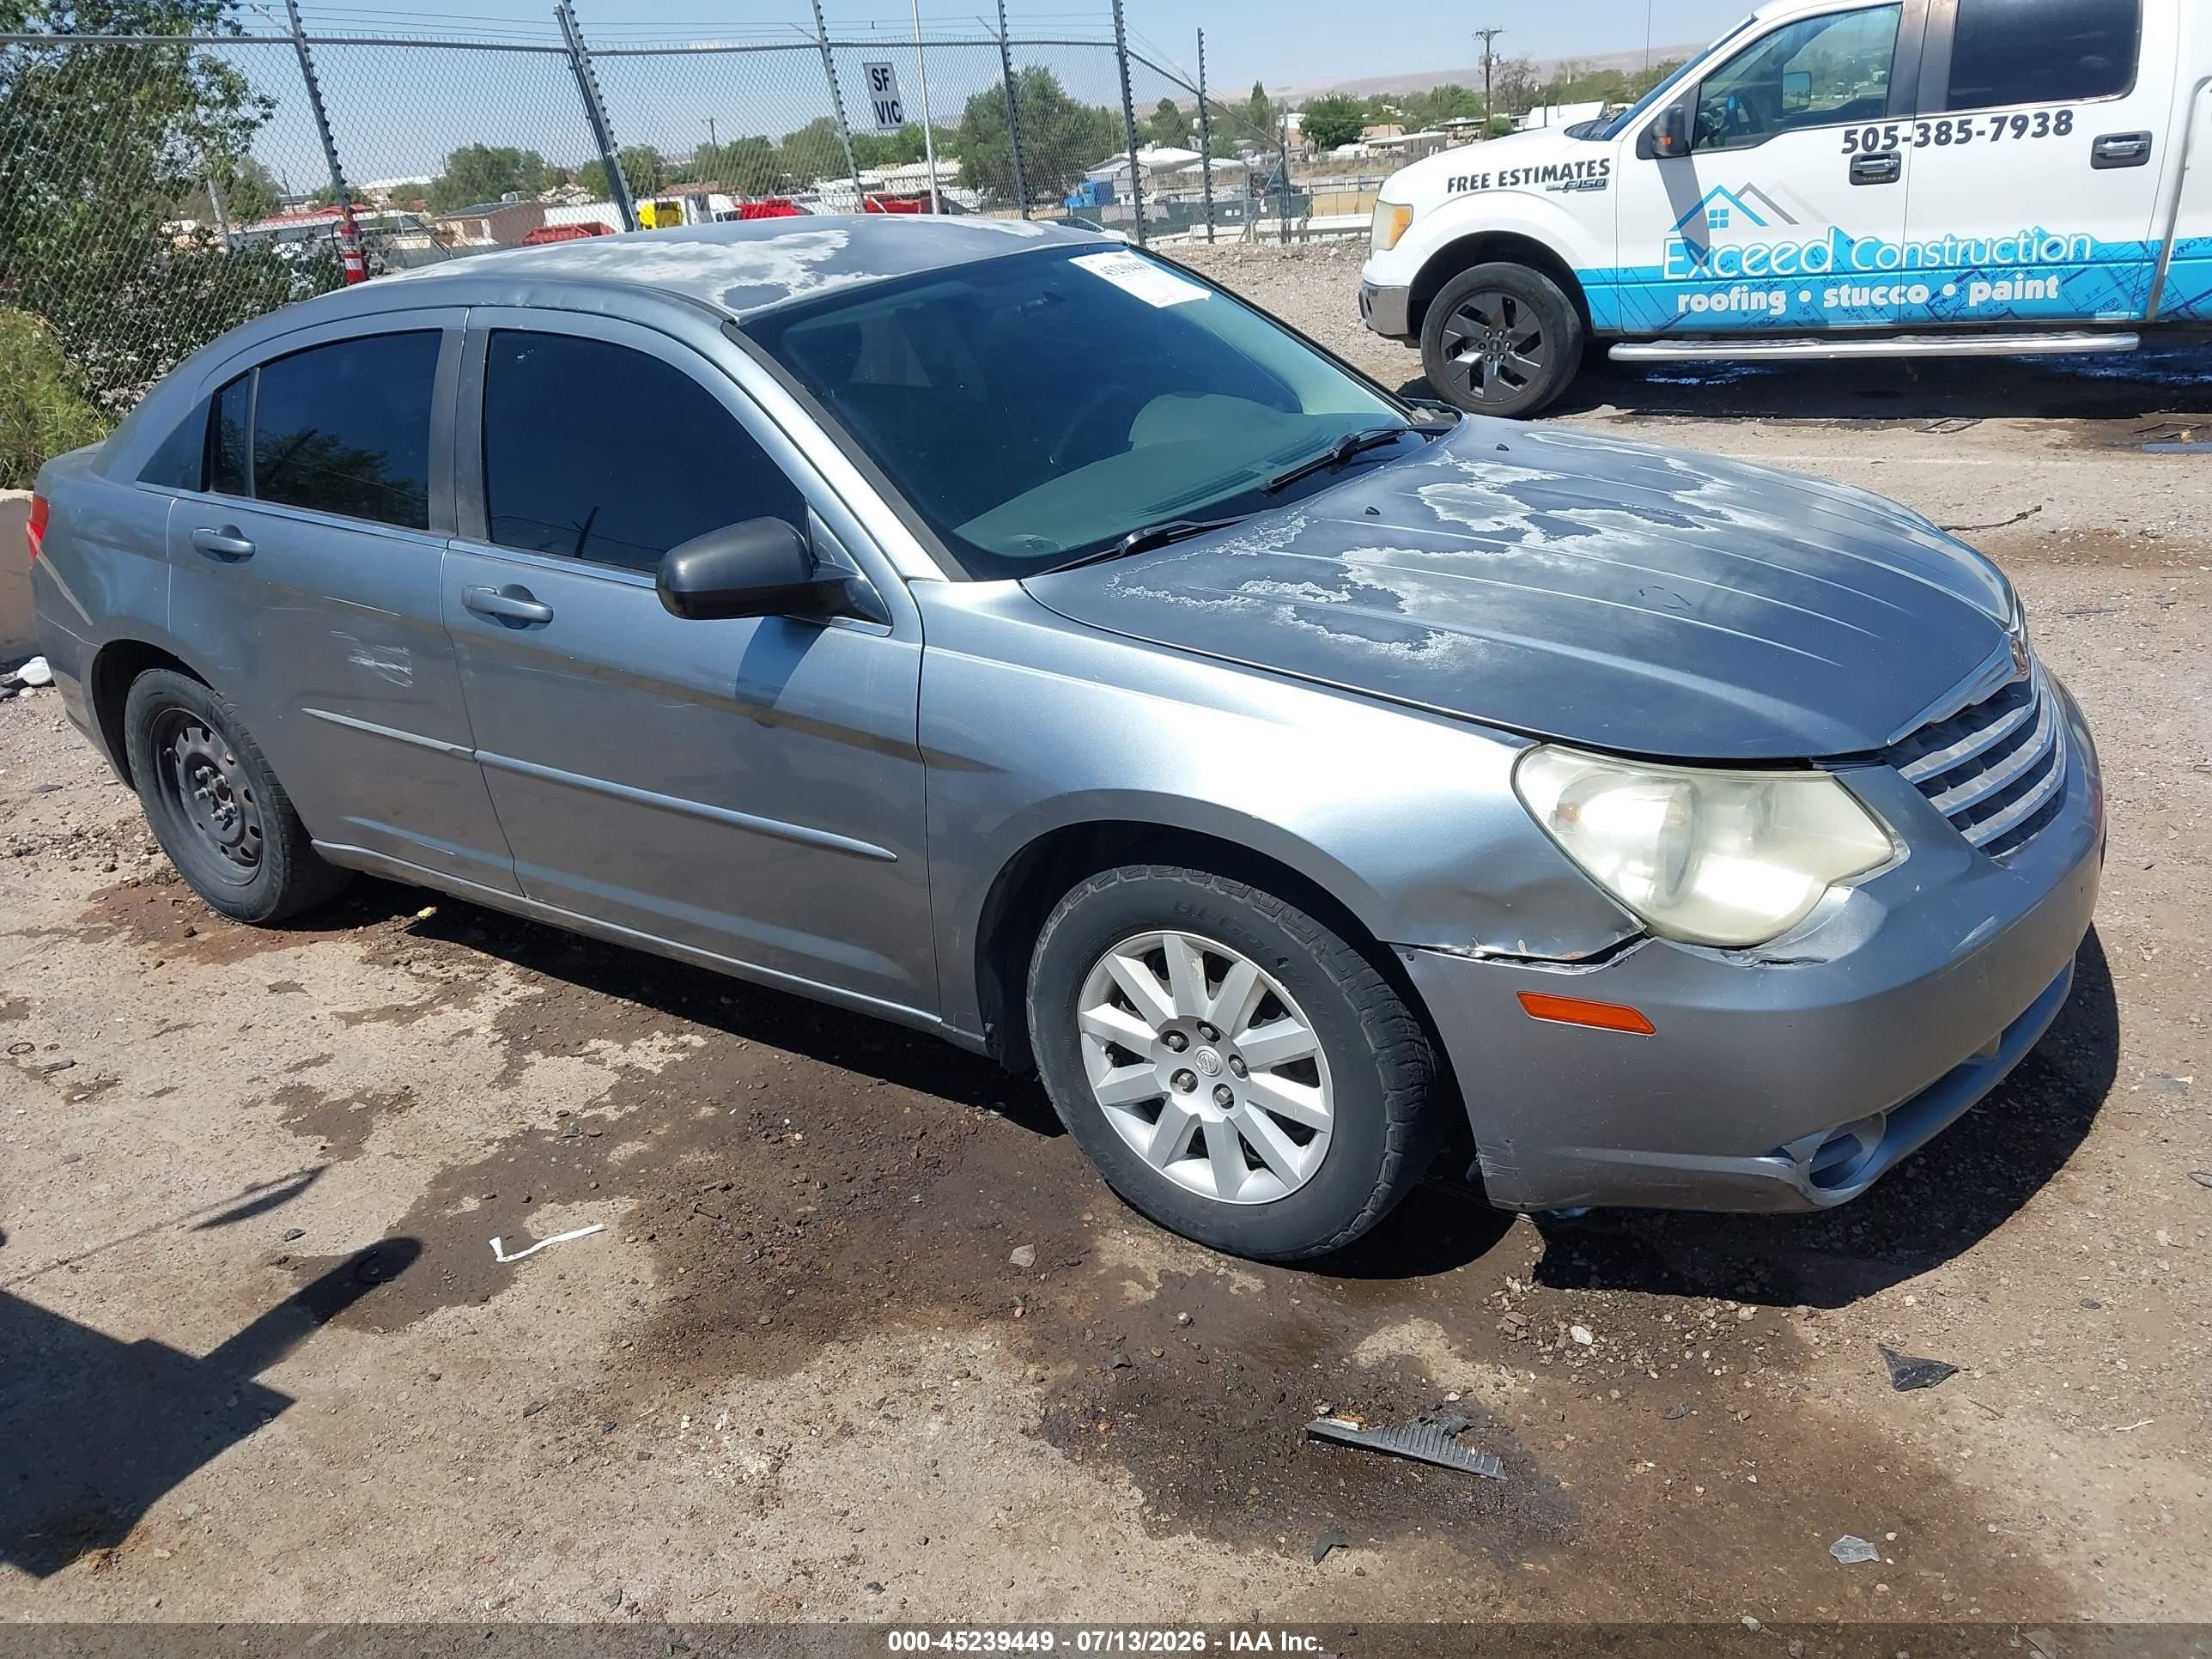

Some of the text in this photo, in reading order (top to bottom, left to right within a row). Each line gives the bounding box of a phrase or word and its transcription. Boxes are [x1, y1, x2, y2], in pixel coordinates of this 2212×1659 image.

[871, 68, 890, 92] SF
[874, 100, 902, 125] VIC
[1840, 109, 2074, 155] 505-385-7938
[1447, 157, 1611, 193] FREE ESTIMATES
[1663, 225, 2093, 280] Exceed Construction
[1677, 285, 1787, 316] roofing
[1823, 284, 1929, 308] stucco
[1967, 271, 2059, 307] paint
